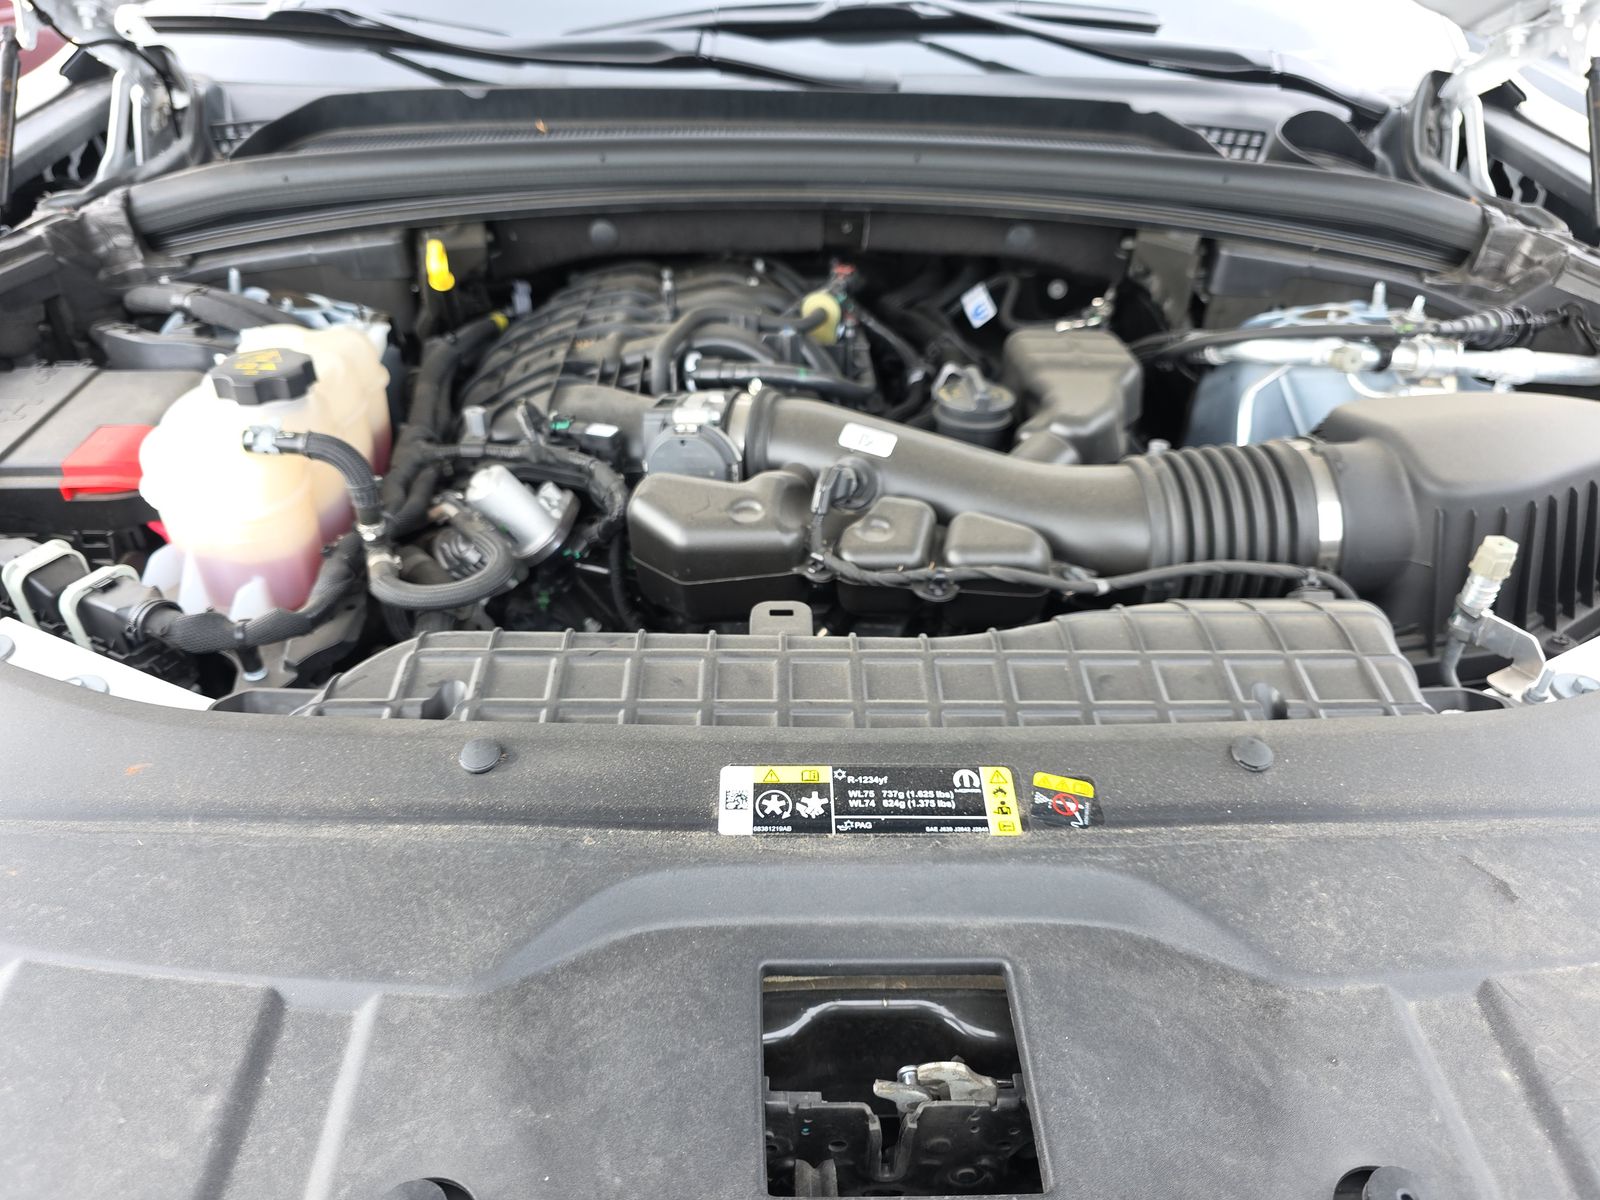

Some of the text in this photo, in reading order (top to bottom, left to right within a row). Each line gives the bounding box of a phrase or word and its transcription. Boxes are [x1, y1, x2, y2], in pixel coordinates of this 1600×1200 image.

[847, 776, 888, 785] R-1234yf
[848, 790, 875, 798] WL75
[882, 790, 904, 799] 737g
[935, 790, 955, 799] lbs)
[849, 800, 876, 808] WL74
[937, 800, 956, 809] lbs)
[854, 821, 873, 829] PAG
